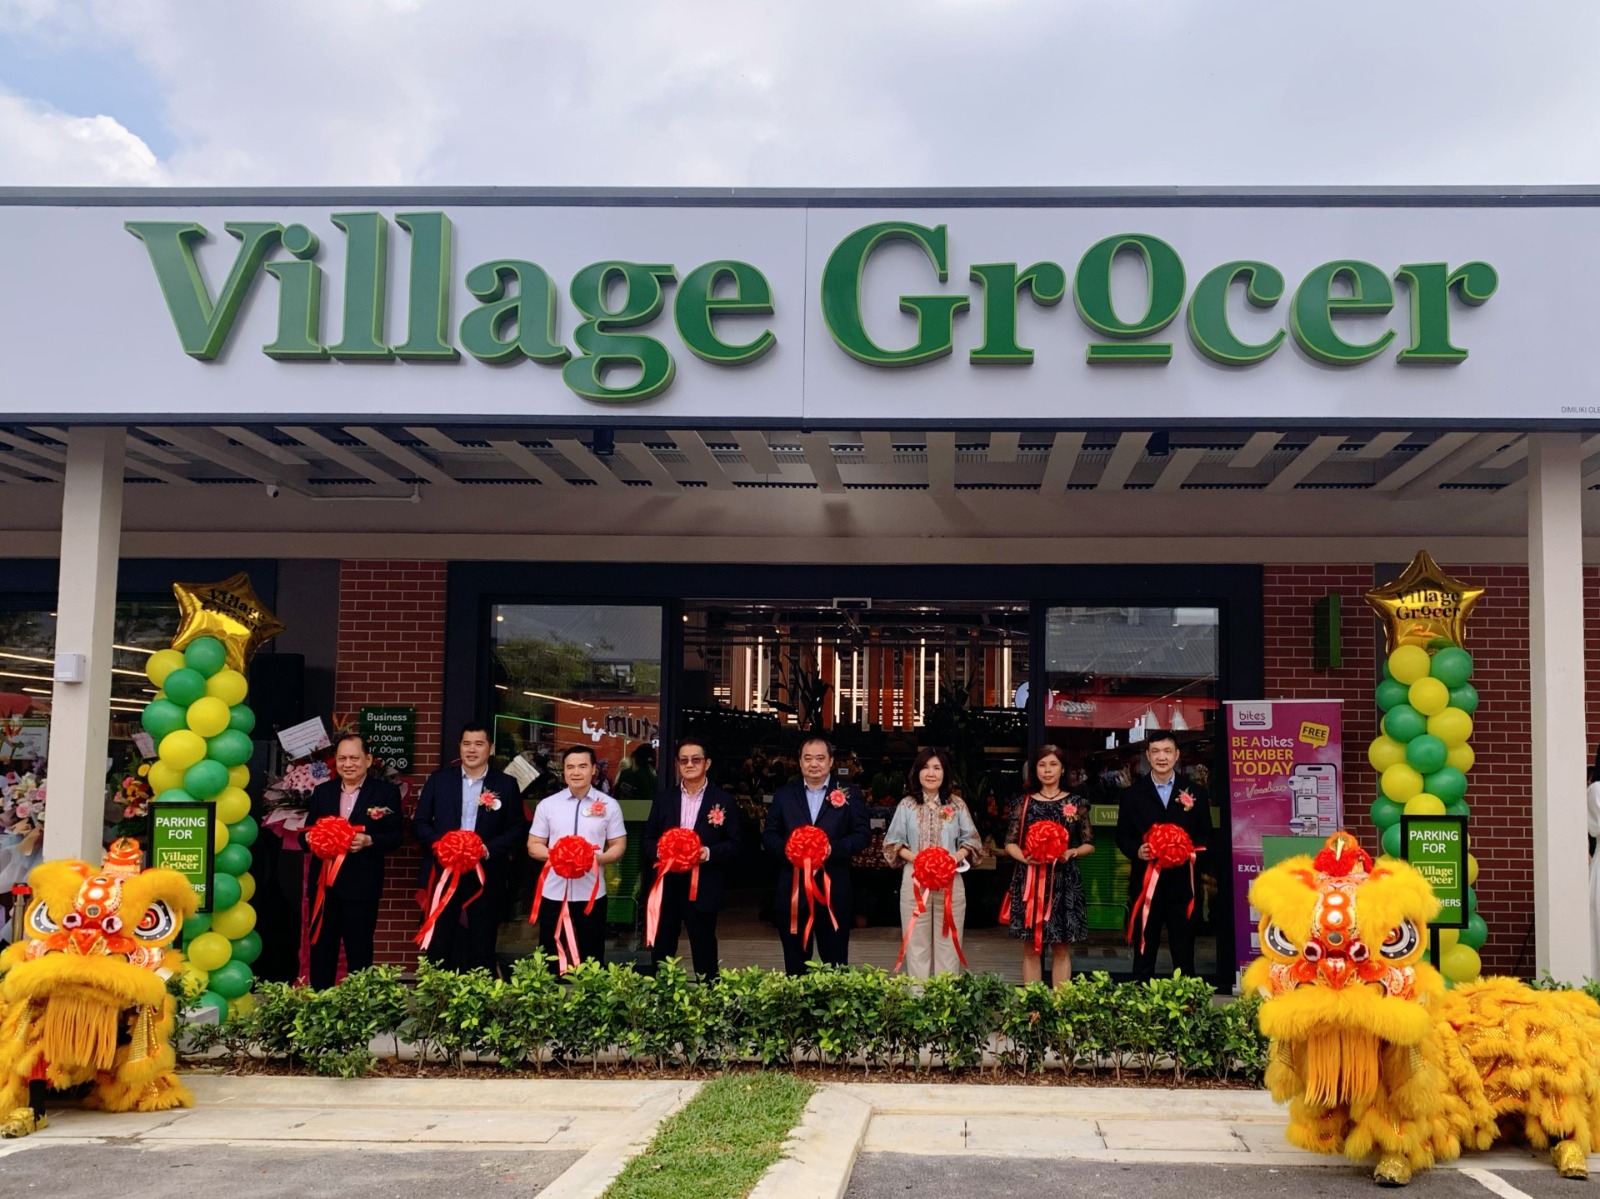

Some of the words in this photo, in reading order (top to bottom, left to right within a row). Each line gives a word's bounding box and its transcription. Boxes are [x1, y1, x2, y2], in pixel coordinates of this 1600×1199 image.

[124, 211, 776, 402] Village
[820, 221, 1498, 367] Grocer
[1396, 589, 1460, 606] Village
[1396, 606, 1460, 620] Grocer
[367, 713, 407, 721] Business
[1239, 711, 1266, 720] bites
[374, 723, 402, 731] Hours
[1302, 726, 1327, 738] FREE
[1232, 736, 1248, 747] BE
[1251, 737, 1261, 747] A
[1261, 736, 1294, 748] bites
[1232, 749, 1294, 760] MEMBER
[1233, 762, 1294, 775] TODAY
[1101, 811, 1119, 819] Vill
[155, 817, 206, 827] PARKING
[168, 830, 193, 839] FOR
[1409, 831, 1459, 841] PARKING
[1422, 843, 1446, 853] FOR
[162, 852, 199, 864] Village
[161, 861, 199, 870] Grocer
[1238, 864, 1265, 872] EXCL
[1417, 866, 1454, 878] Village
